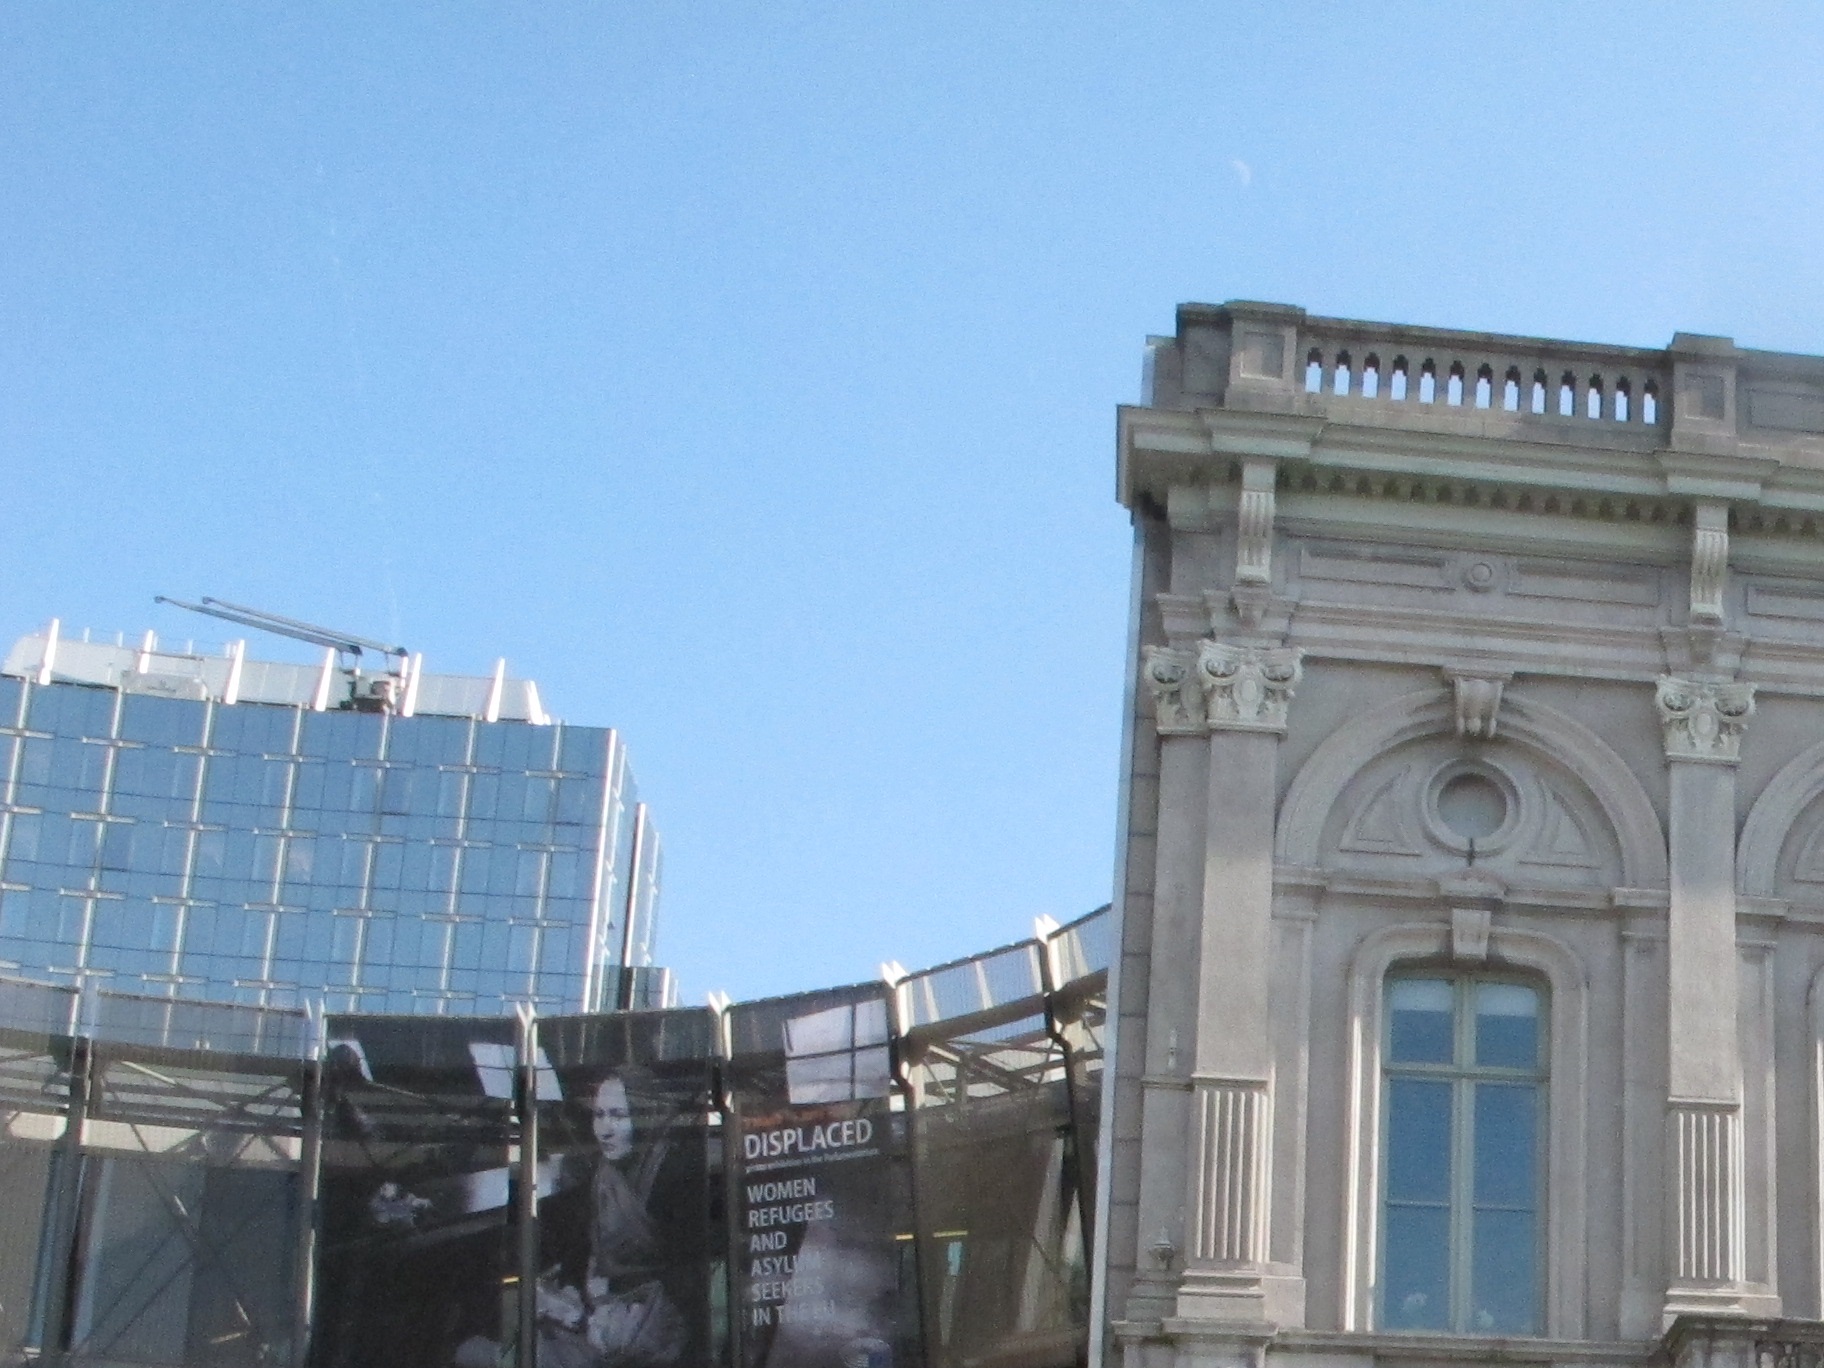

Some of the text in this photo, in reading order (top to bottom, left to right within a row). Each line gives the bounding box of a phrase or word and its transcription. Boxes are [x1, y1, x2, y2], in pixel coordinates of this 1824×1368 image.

[744, 1118, 873, 1160] DISPLACED
[747, 1177, 816, 1204] WOMEN
[748, 1200, 835, 1228] REFUGEES
[750, 1230, 788, 1253] AND
[750, 1275, 825, 1303] SEEKERS
[752, 1307, 771, 1326] IN
